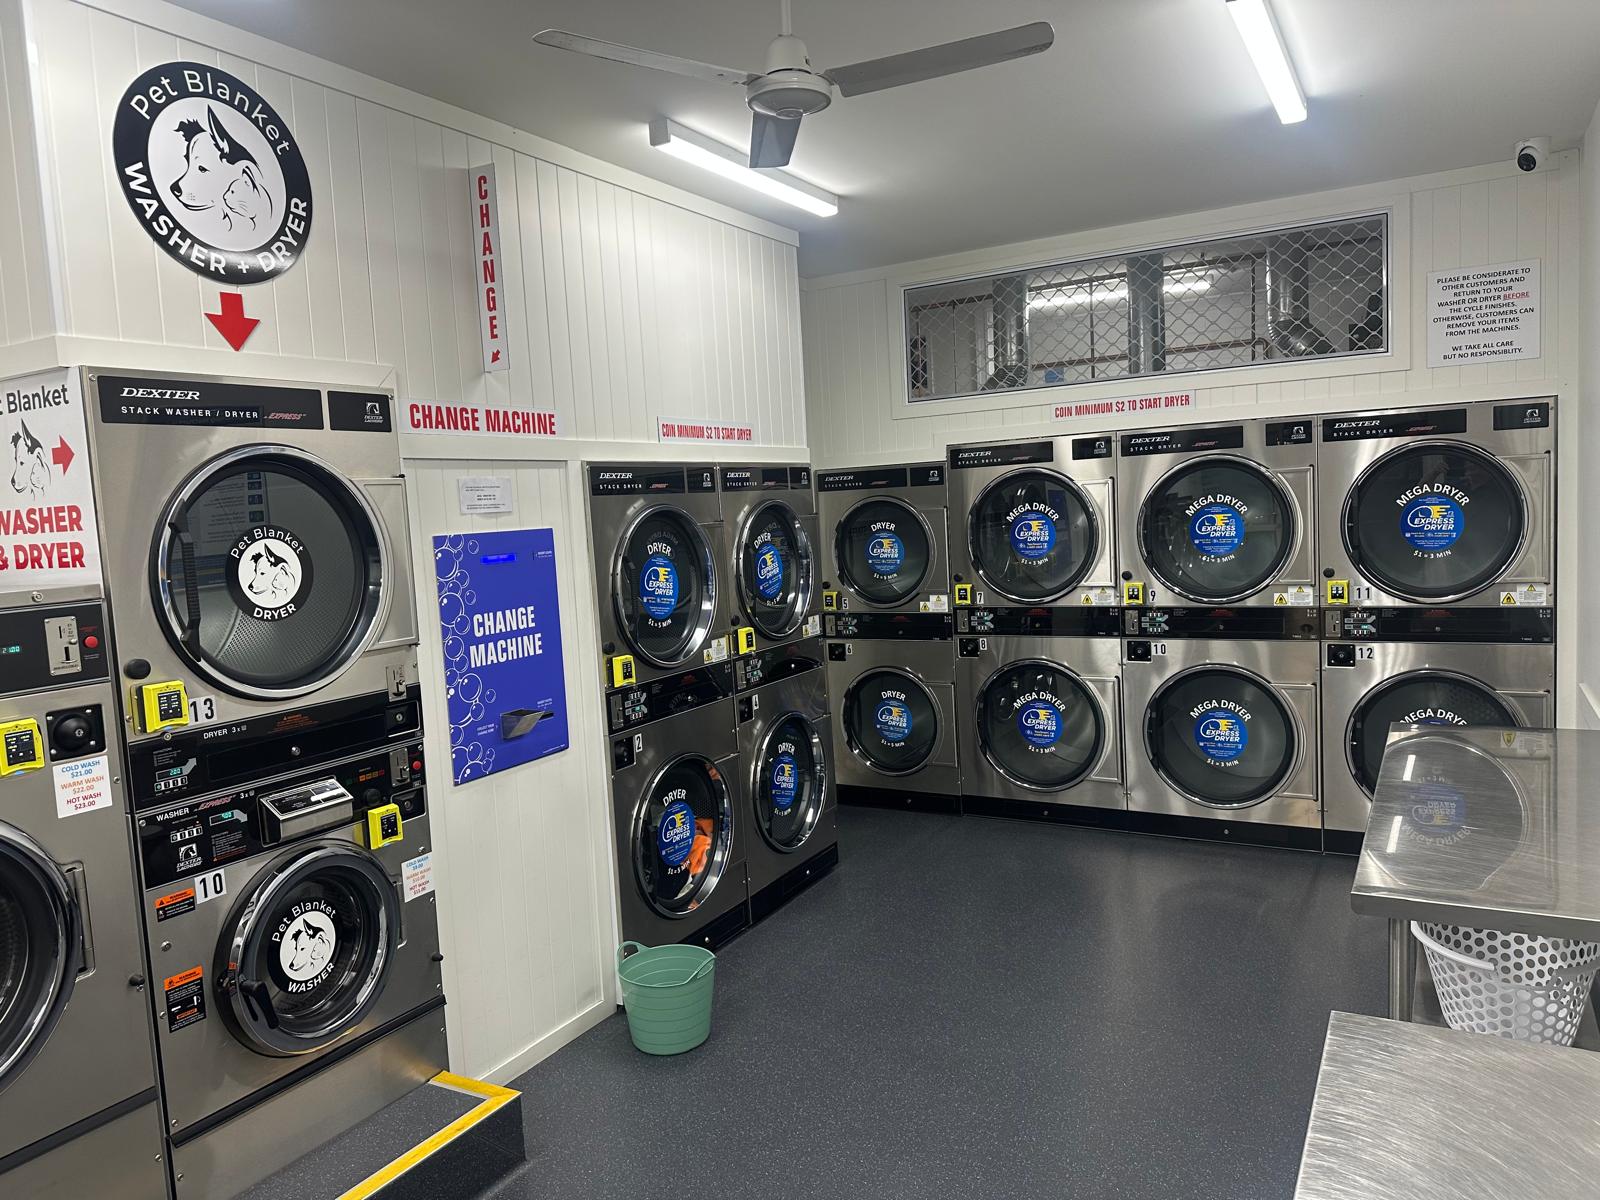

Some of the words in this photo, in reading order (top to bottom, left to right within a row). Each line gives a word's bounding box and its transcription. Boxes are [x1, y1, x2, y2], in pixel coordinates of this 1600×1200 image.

[130, 76, 177, 119] Pet
[183, 70, 291, 156] Blanket
[125, 161, 226, 275] WASHER
[258, 197, 308, 273] DRYER
[477, 175, 498, 340] CHANGE
[1437, 275, 1461, 284] PLEASE
[1472, 268, 1519, 280] CONSIDERATE
[1466, 278, 1508, 289] CUSTOMERS
[1453, 289, 1481, 297] RETURN
[1493, 285, 1513, 293] YOUR
[1437, 298, 1466, 308] WASHER
[1479, 295, 1501, 303] DRYER
[1503, 291, 1530, 300] BEFORE
[1484, 301, 1517, 310] FINISHES.
[1432, 314, 1474, 323] OTHERWISE,
[1476, 308, 1518, 319] CUSTOMERS
[1446, 321, 1476, 329] REMOVE
[1477, 318, 1497, 326] YOUR
[1498, 316, 1520, 324] ITEMS
[1445, 329, 1466, 337] FROM
[1482, 324, 1520, 333] MACHINES.
[1496, 340, 1514, 348] CARE
[6, 384, 69, 414] Blanket
[120, 387, 200, 400] DEXTER
[121, 406, 160, 417] STACK
[166, 407, 211, 417] WASHER
[225, 410, 258, 419] DRYER
[1055, 407, 1072, 418] COIN
[1075, 402, 1112, 416] MINIMUM
[1115, 401, 1125, 412] $2
[1128, 400, 1137, 411] TO
[1140, 397, 1162, 410] START
[1165, 395, 1190, 408] DRYER
[409, 403, 479, 432] CHANGE
[485, 408, 556, 435] MACHINE
[1334, 420, 1380, 428] DEXTER
[662, 423, 676, 437] COIN
[677, 424, 705, 439] MINIMUM
[706, 426, 713, 439] $2
[714, 427, 720, 439] TO
[721, 427, 736, 440] START
[737, 427, 752, 440] DRYER
[1131, 436, 1170, 444] DEXTER
[1396, 484, 1431, 507] MEGA
[1433, 483, 1470, 506] DRYER
[1006, 503, 1031, 522] MEGA
[1032, 502, 1059, 521] DRYER
[1185, 495, 1215, 517] MEGA
[1217, 494, 1248, 514] DRYER
[871, 521, 895, 531] DRYER
[231, 535, 252, 559] Pet
[253, 527, 304, 554] Blanket
[754, 532, 771, 548] DRYER
[14, 541, 86, 570] DRYER
[647, 542, 671, 556] DRYER
[649, 580, 673, 589] EXPRESS
[655, 588, 673, 596] DRYER
[978, 593, 982, 602] 7
[1151, 590, 1156, 601] 9
[1356, 587, 1371, 600] 11
[843, 598, 848, 609] 5
[253, 603, 297, 620] DRYER
[473, 605, 535, 637] CHANGE
[469, 633, 543, 669] MACHINE
[1153, 644, 1166, 655] 10
[1359, 648, 1373, 659] 12
[881, 691, 906, 701] DRYER
[1013, 692, 1038, 709] MEGA
[1039, 691, 1066, 712] DRYER
[190, 700, 215, 723] 13
[1190, 700, 1219, 719] MEGA
[1221, 700, 1251, 722] DRYER
[1400, 708, 1434, 724] MEGA
[203, 728, 228, 740] DRYER
[636, 735, 642, 751] 2
[778, 742, 795, 755] DRYER
[61, 764, 79, 773] COLD
[81, 760, 100, 769] WASH
[71, 768, 93, 778] $21.00
[61, 781, 83, 790] WARM
[85, 775, 104, 784] WASH
[73, 784, 94, 794] $22.00
[66, 796, 80, 805] HOT
[82, 792, 101, 801] WASH
[74, 800, 96, 810] $23.00
[663, 789, 686, 807] DRYER
[156, 807, 190, 822] WASHER
[667, 823, 690, 838] EXPRESS
[672, 830, 691, 842] DRYER
[199, 872, 223, 898] 10
[272, 917, 291, 943] Pet
[292, 900, 337, 920] Blanket
[288, 962, 335, 993] WASHER
